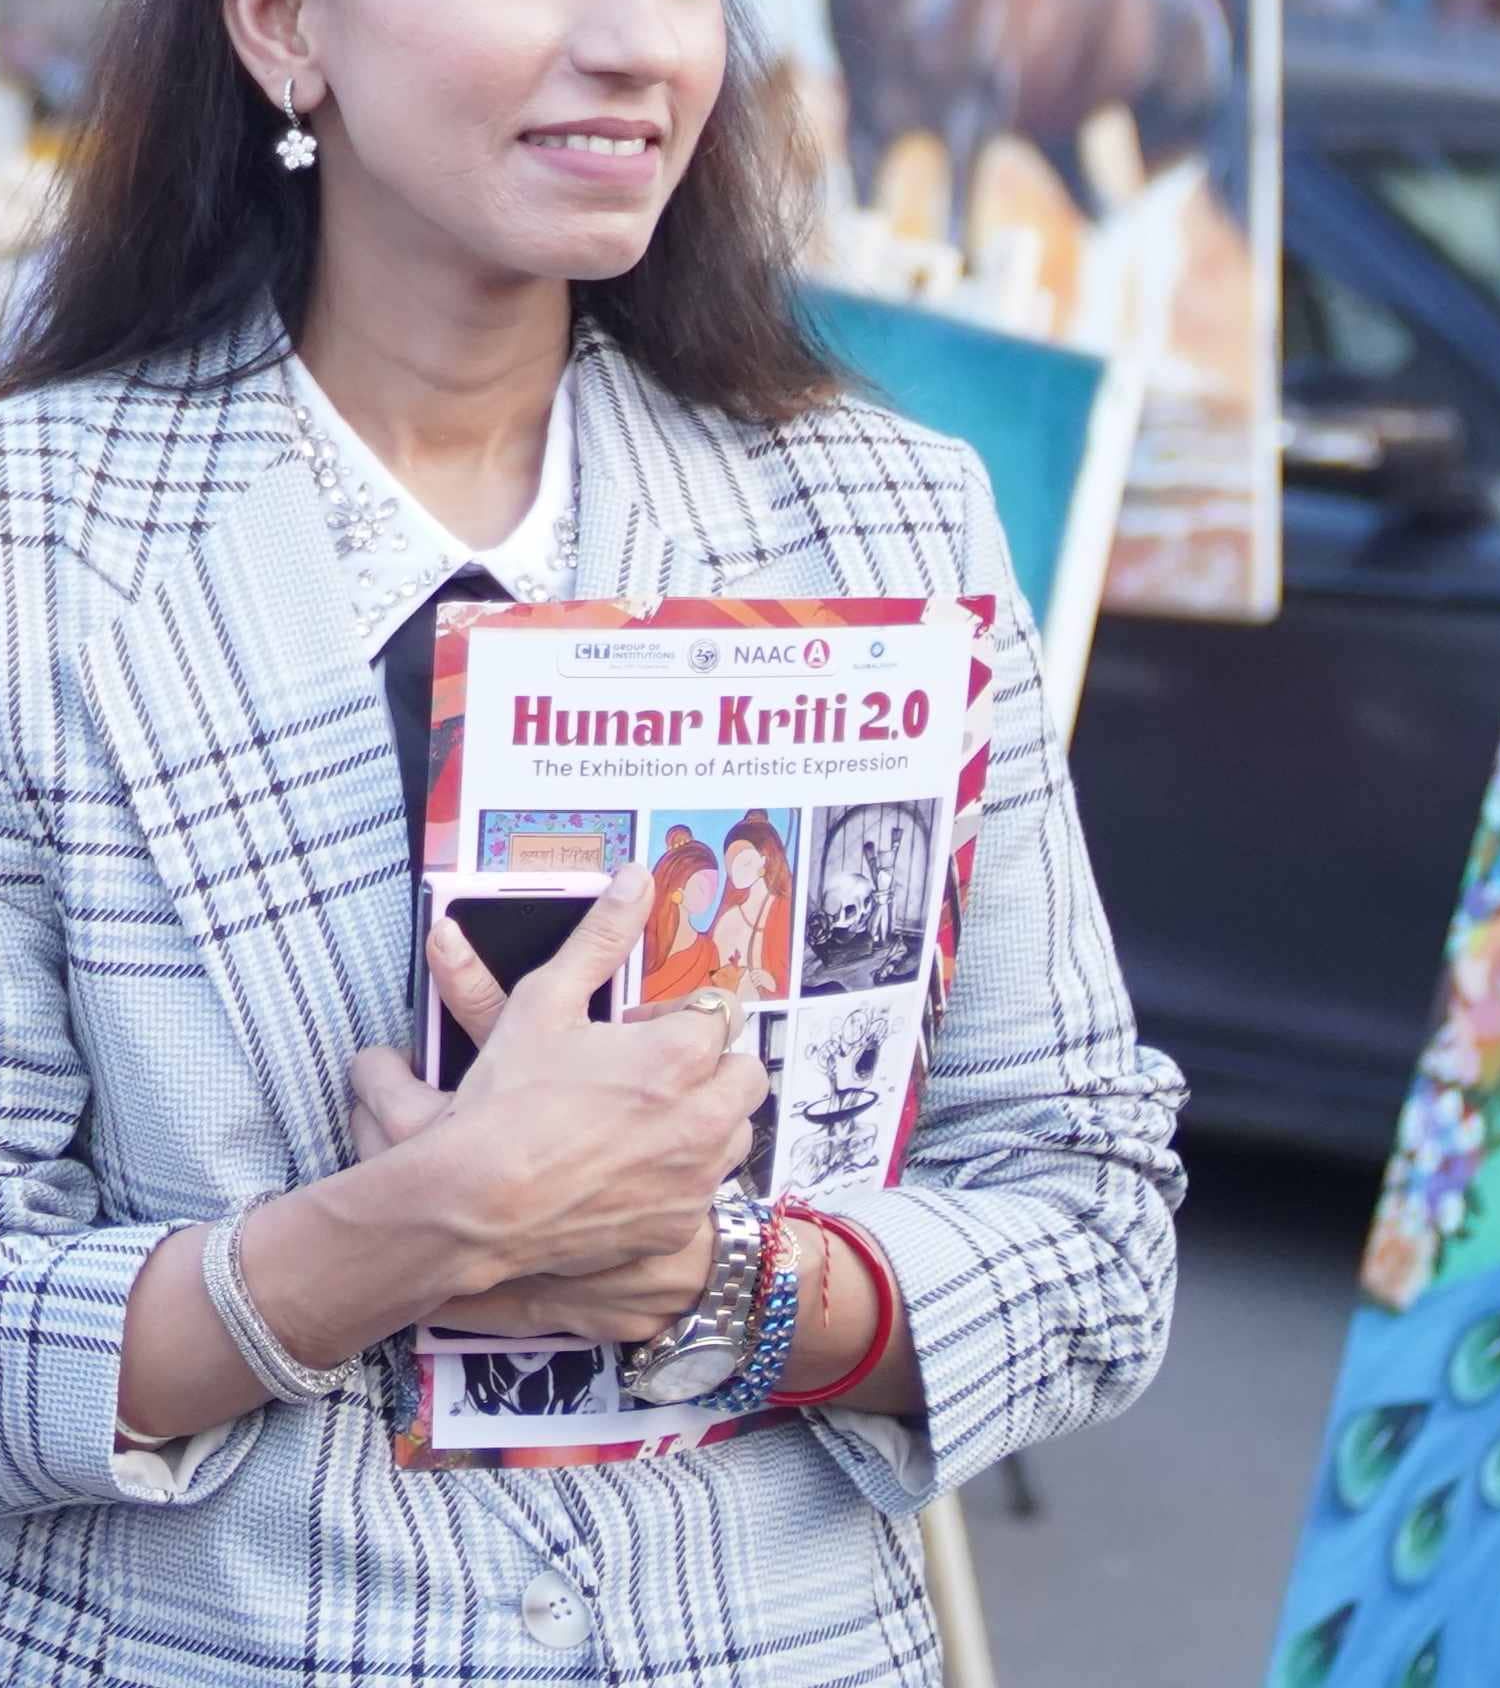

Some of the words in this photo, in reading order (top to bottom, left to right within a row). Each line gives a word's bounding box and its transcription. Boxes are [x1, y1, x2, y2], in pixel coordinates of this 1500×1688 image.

[734, 645, 797, 664] NAAC
[512, 695, 704, 746] Hunar
[717, 693, 848, 745] Kriti
[858, 689, 930, 741] 2.0
[532, 759, 572, 777] The
[580, 758, 688, 777] Exhibition
[695, 757, 716, 777] of
[721, 756, 797, 776] Artistic
[803, 752, 909, 780] Expression
